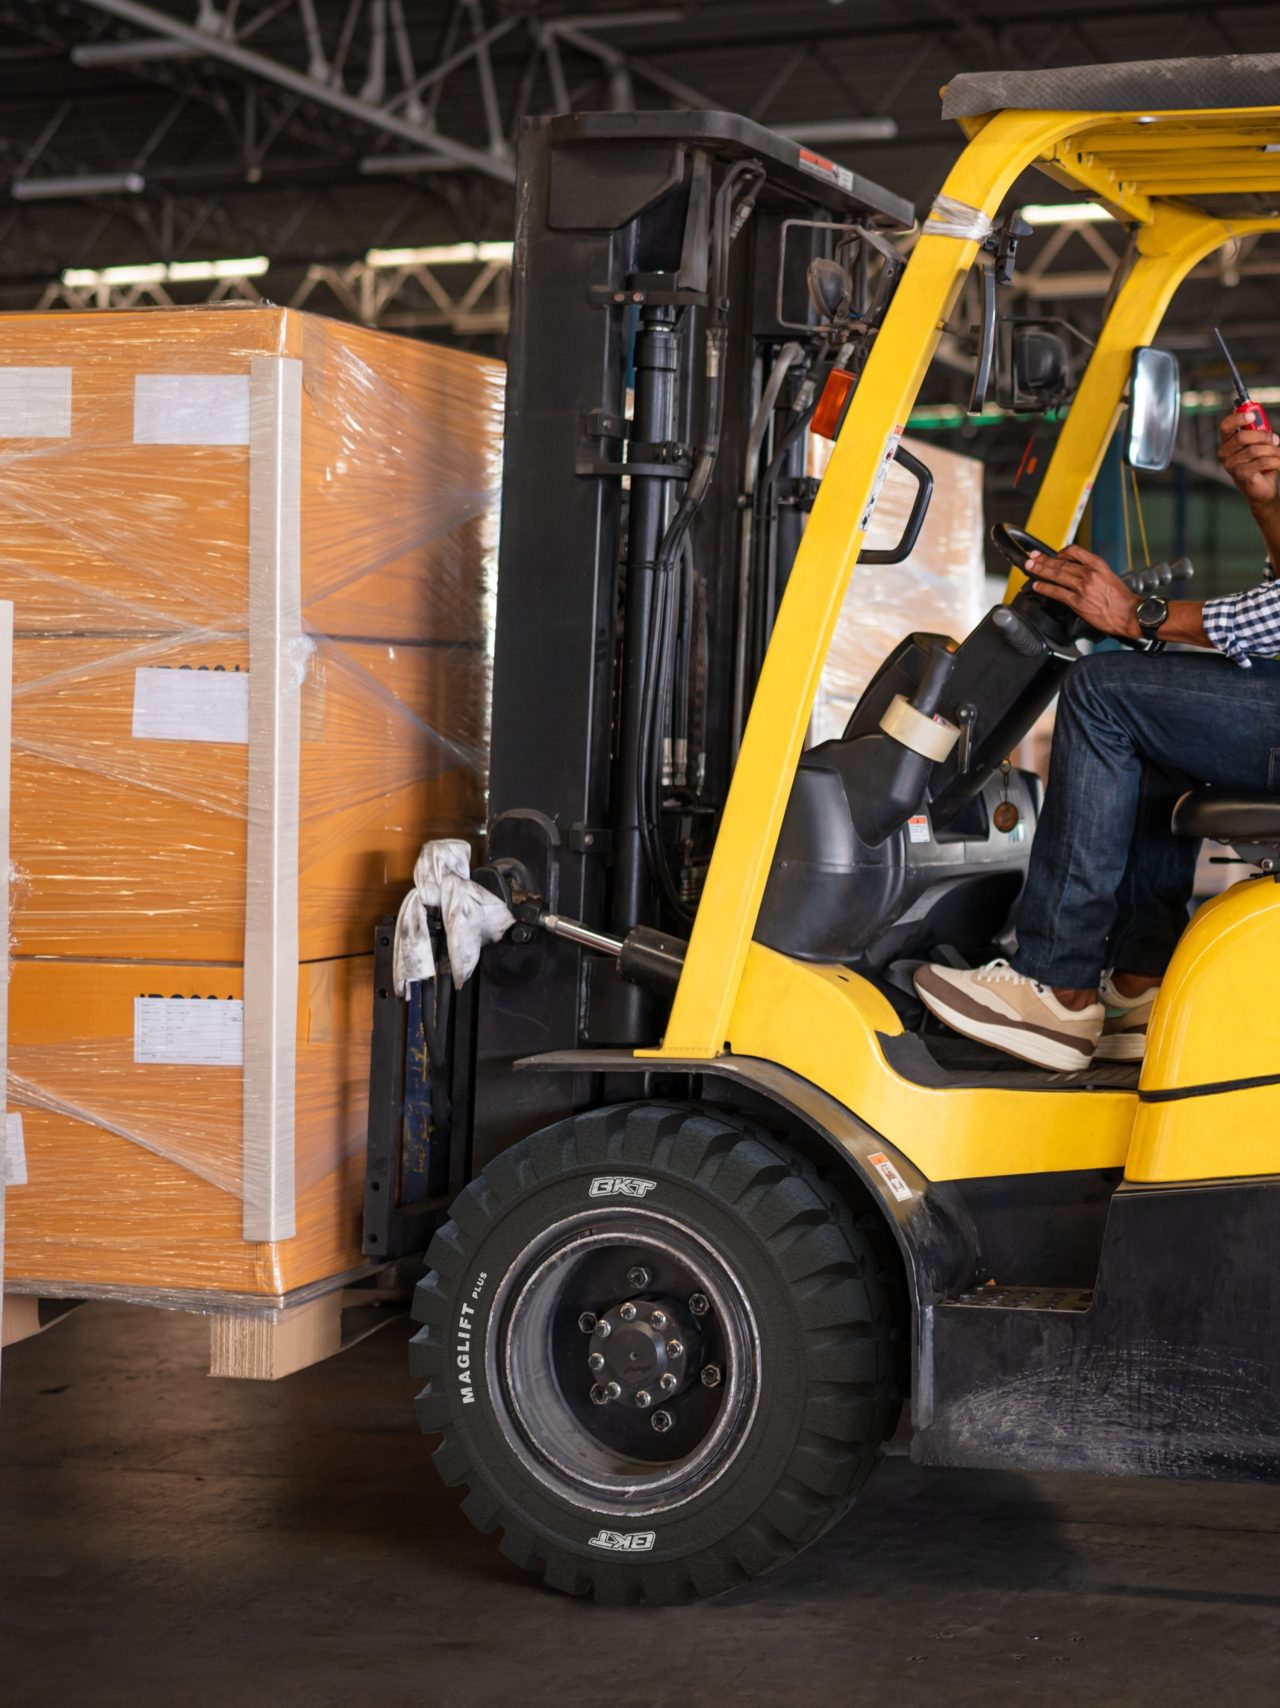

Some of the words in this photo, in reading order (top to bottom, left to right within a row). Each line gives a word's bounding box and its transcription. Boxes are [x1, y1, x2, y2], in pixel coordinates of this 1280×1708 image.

[589, 1176, 657, 1198] BKT
[457, 1302, 475, 1404] MAGLIFT
[472, 1271, 488, 1300] PLUS
[588, 1530, 656, 1551] BKT
